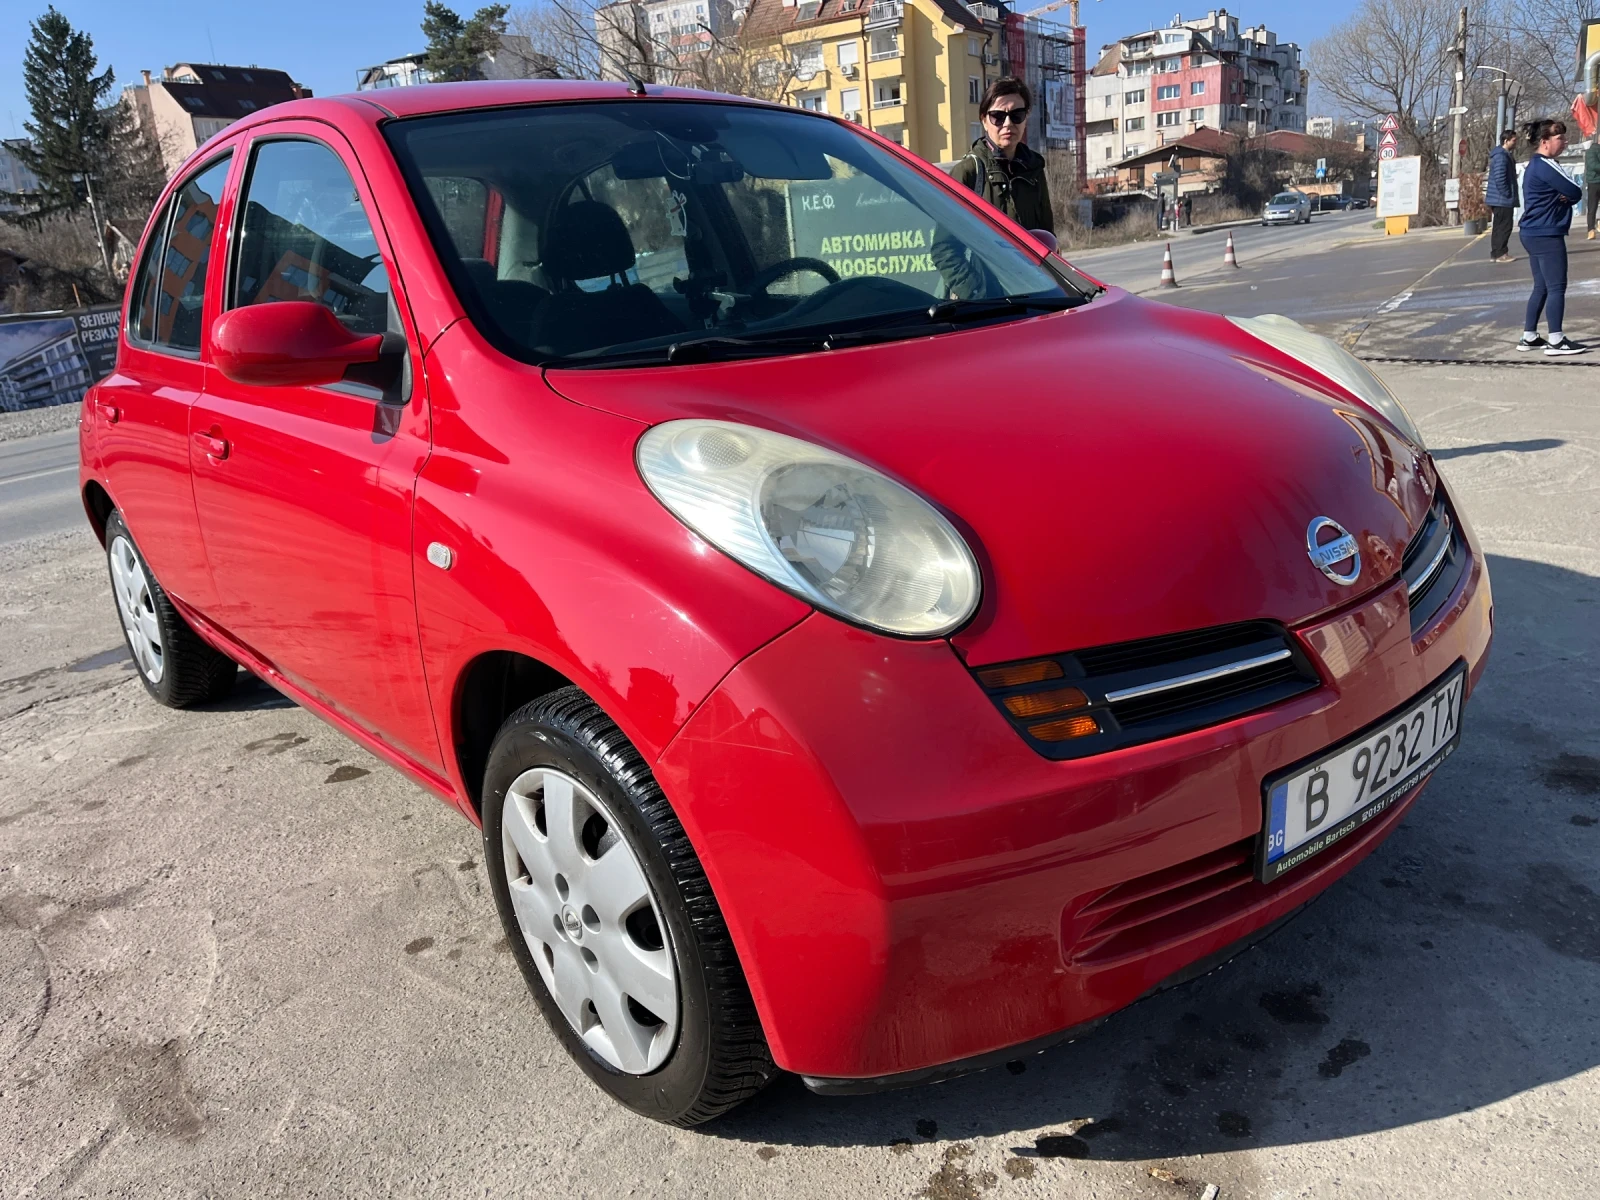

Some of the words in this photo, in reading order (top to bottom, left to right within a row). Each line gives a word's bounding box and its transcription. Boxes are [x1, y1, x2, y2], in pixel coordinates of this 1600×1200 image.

[1383, 150, 1393, 158] 30
[821, 230, 925, 254] АВТОМИВКА
[81, 326, 119, 342] РЕЗИД
[1305, 769, 1330, 833] B
[1352, 711, 1425, 805] 9232
[1431, 681, 1459, 748] TX
[1268, 829, 1284, 852] BG
[1276, 841, 1324, 874] Automobile
[1325, 820, 1356, 845] Bartsch
